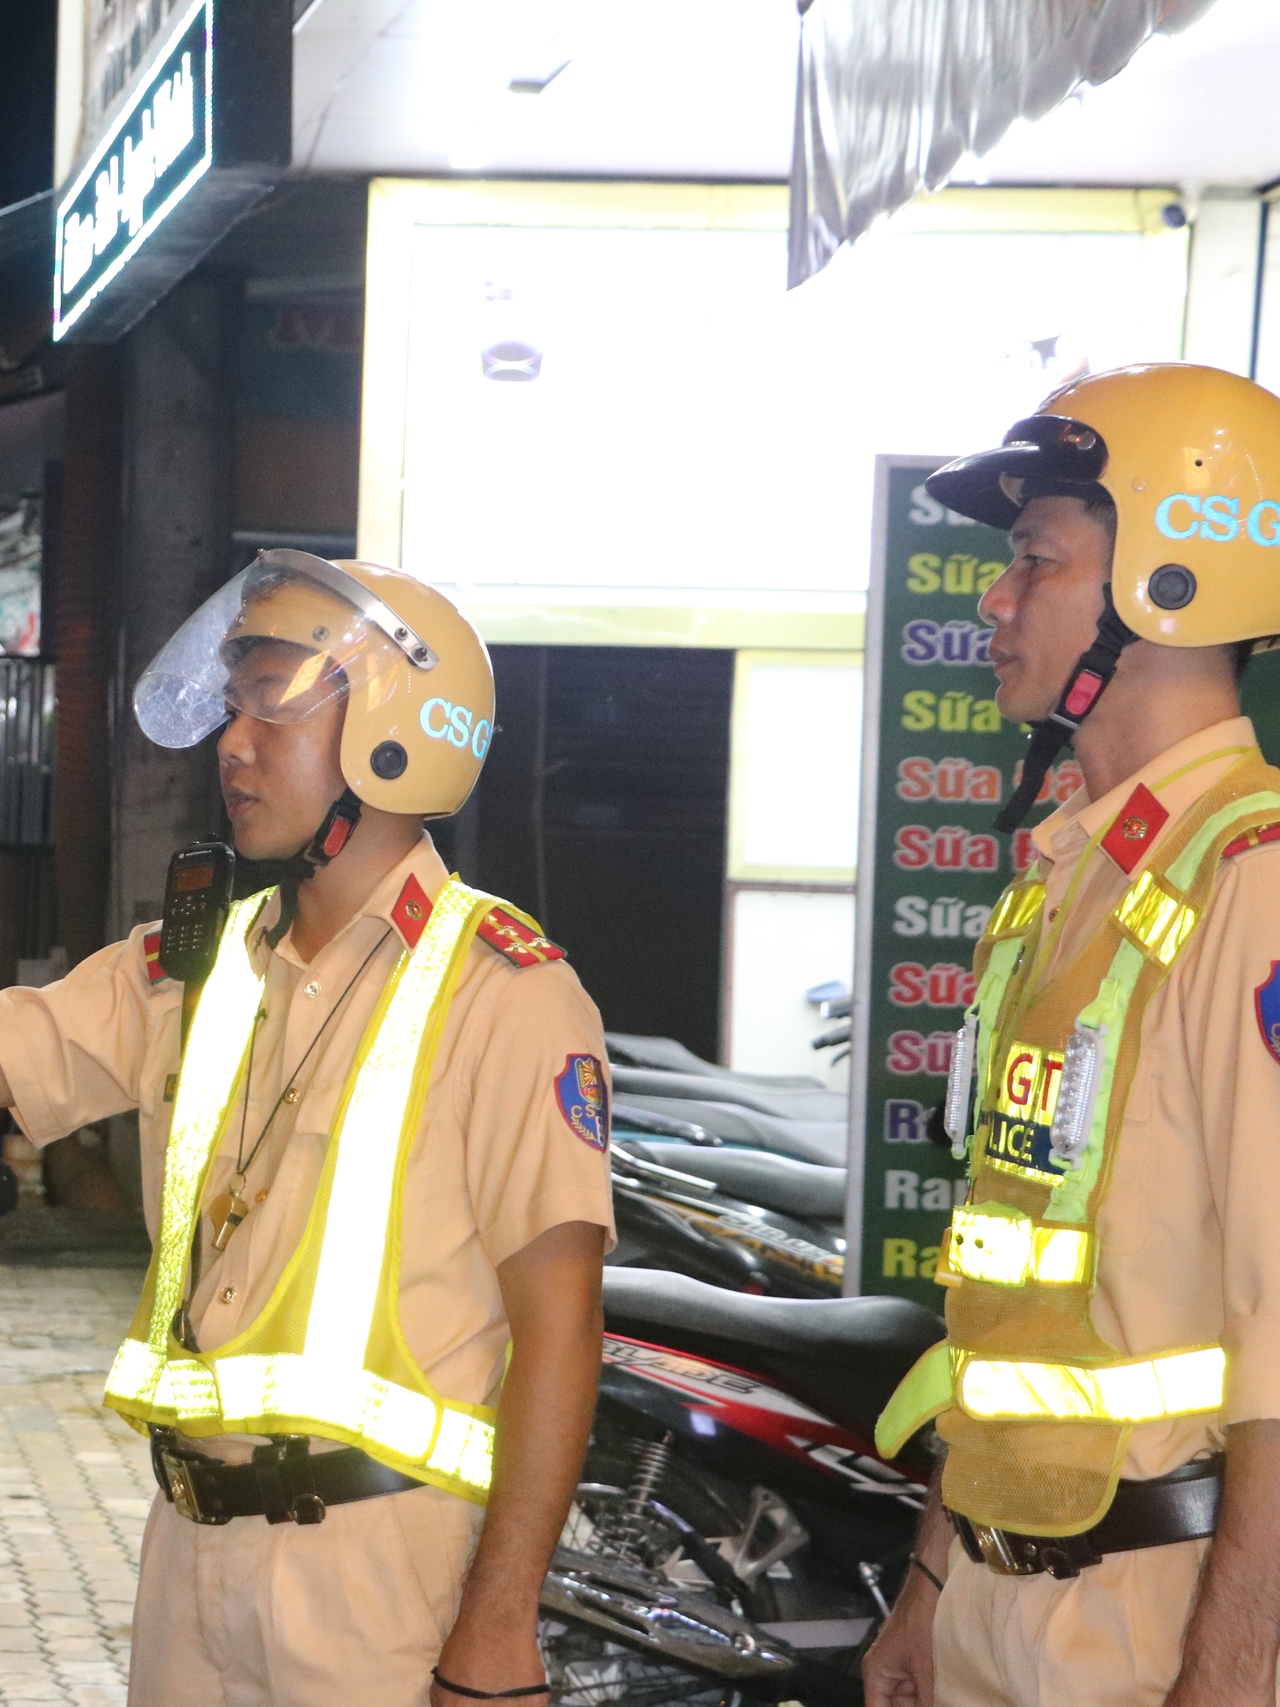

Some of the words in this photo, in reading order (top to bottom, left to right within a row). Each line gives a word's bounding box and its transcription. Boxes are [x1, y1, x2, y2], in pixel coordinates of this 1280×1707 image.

[1155, 493, 1280, 547] CSG
[419, 697, 493, 759] CSG
[901, 690, 1001, 733] Sữa
[897, 756, 1001, 803] Sữa
[894, 824, 1000, 872] Sữa
[892, 895, 993, 938] Sữa
[997, 1053, 1063, 1111] GT
